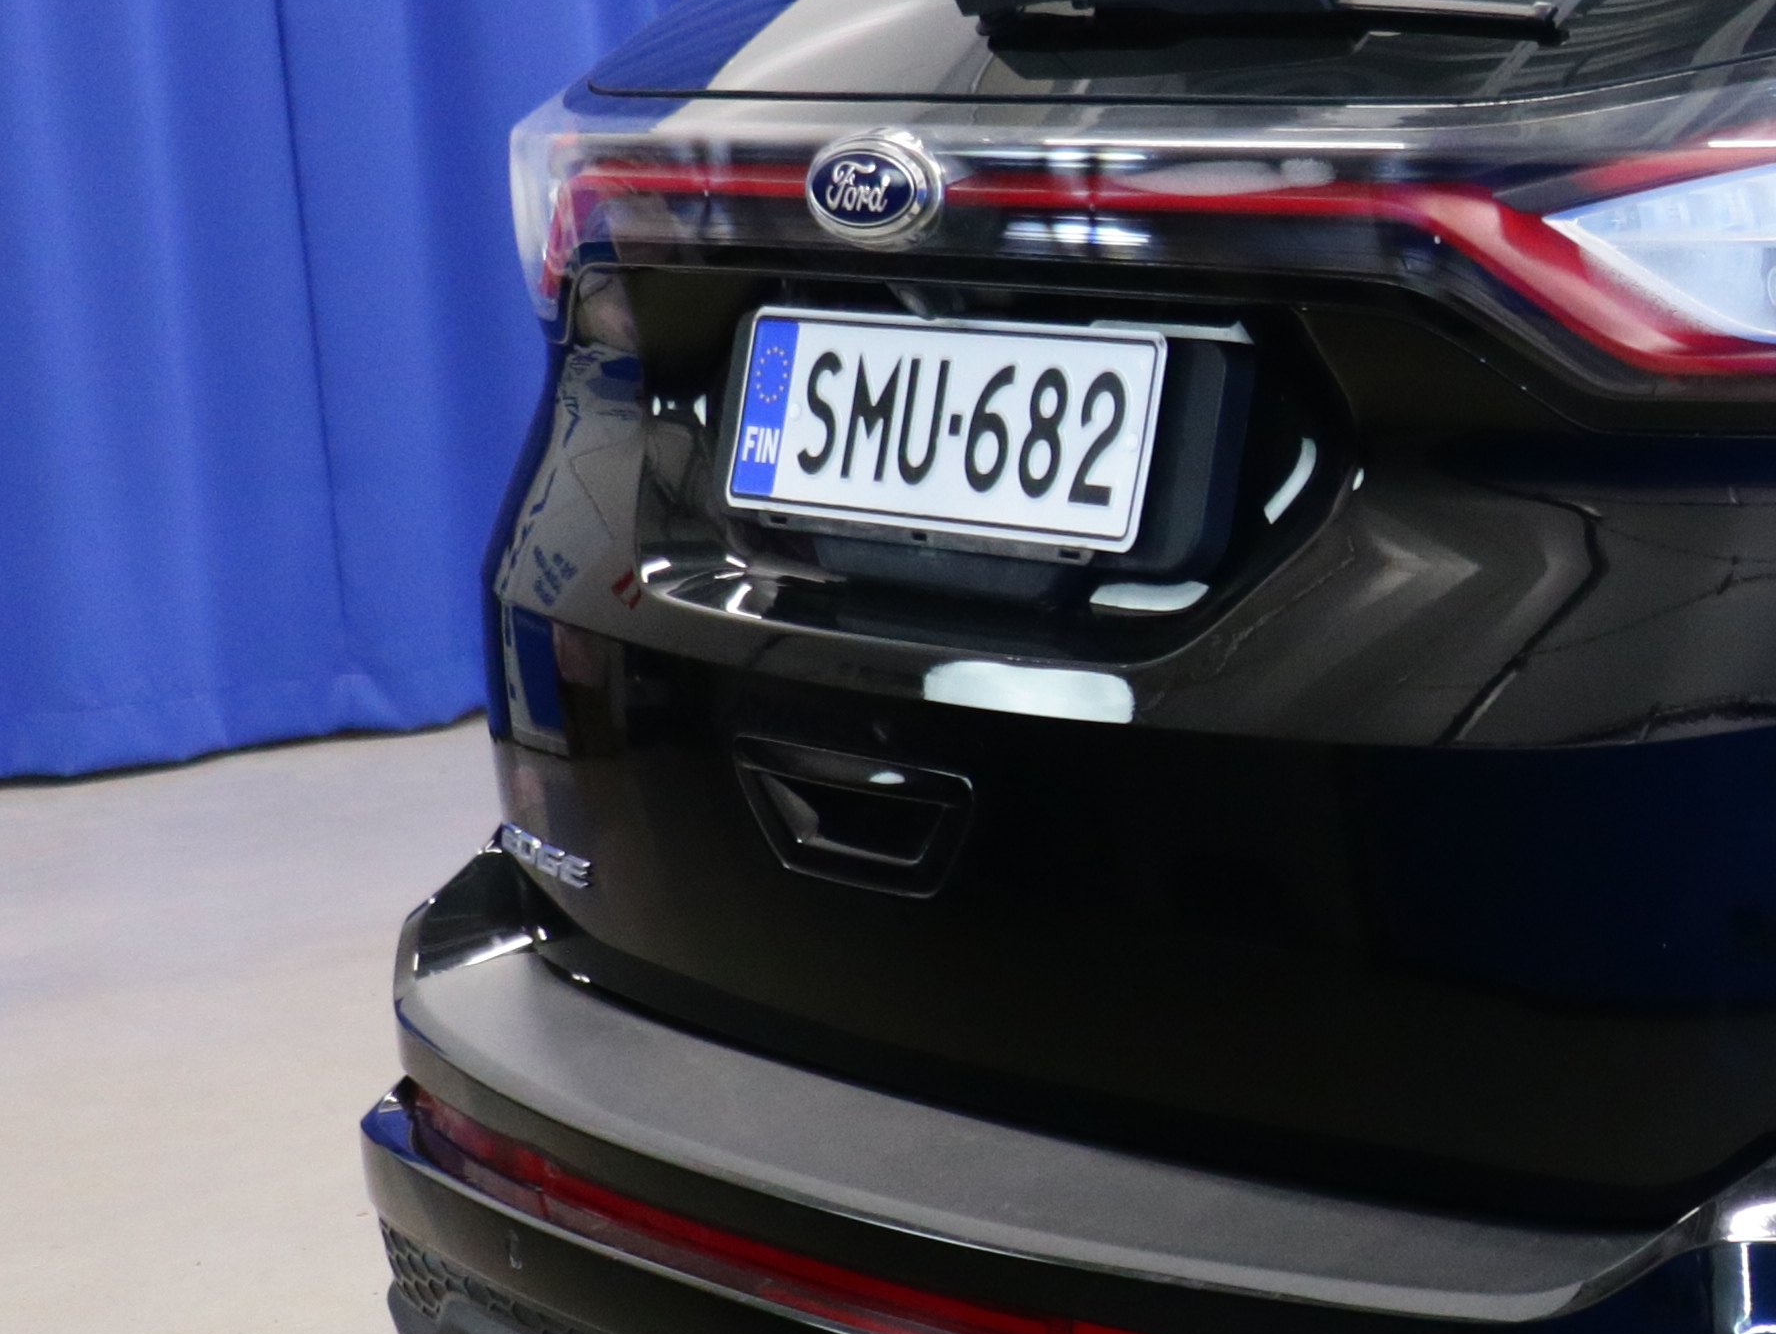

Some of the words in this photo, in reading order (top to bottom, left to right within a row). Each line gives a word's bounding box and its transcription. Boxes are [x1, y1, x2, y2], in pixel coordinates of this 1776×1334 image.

[826, 160, 888, 213] Ford
[741, 425, 780, 465] FIN
[797, 351, 1126, 506] SMU-682
